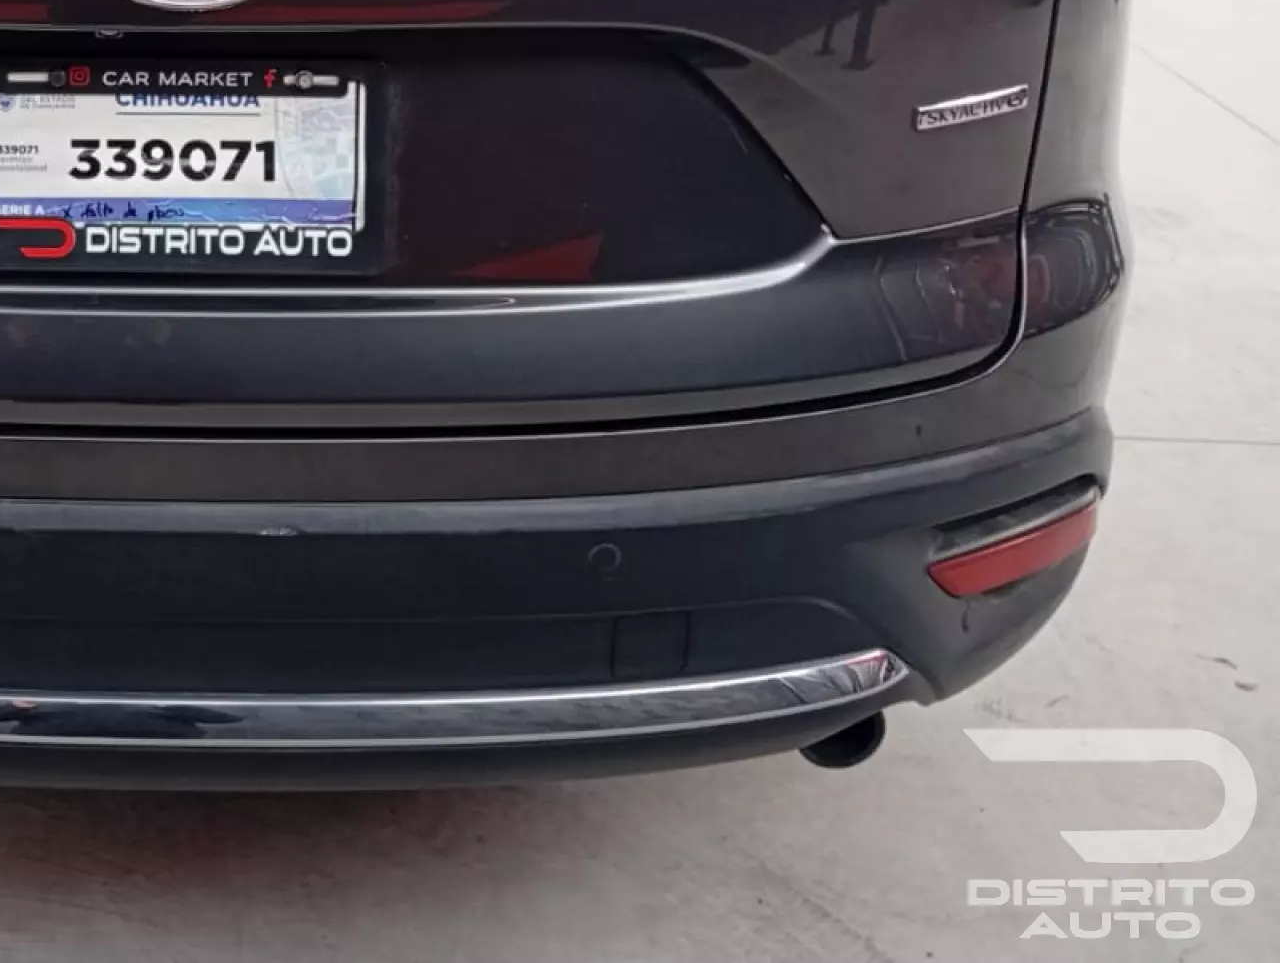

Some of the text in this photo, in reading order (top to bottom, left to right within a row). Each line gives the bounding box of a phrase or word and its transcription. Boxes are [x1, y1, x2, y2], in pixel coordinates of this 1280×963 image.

[102, 71, 254, 87] CAR MARKET
[115, 93, 260, 107] CHIHUAHUA
[68, 139, 276, 182] 339071
[34, 204, 46, 215] A
[85, 227, 353, 256] DISTRITO AUTO
